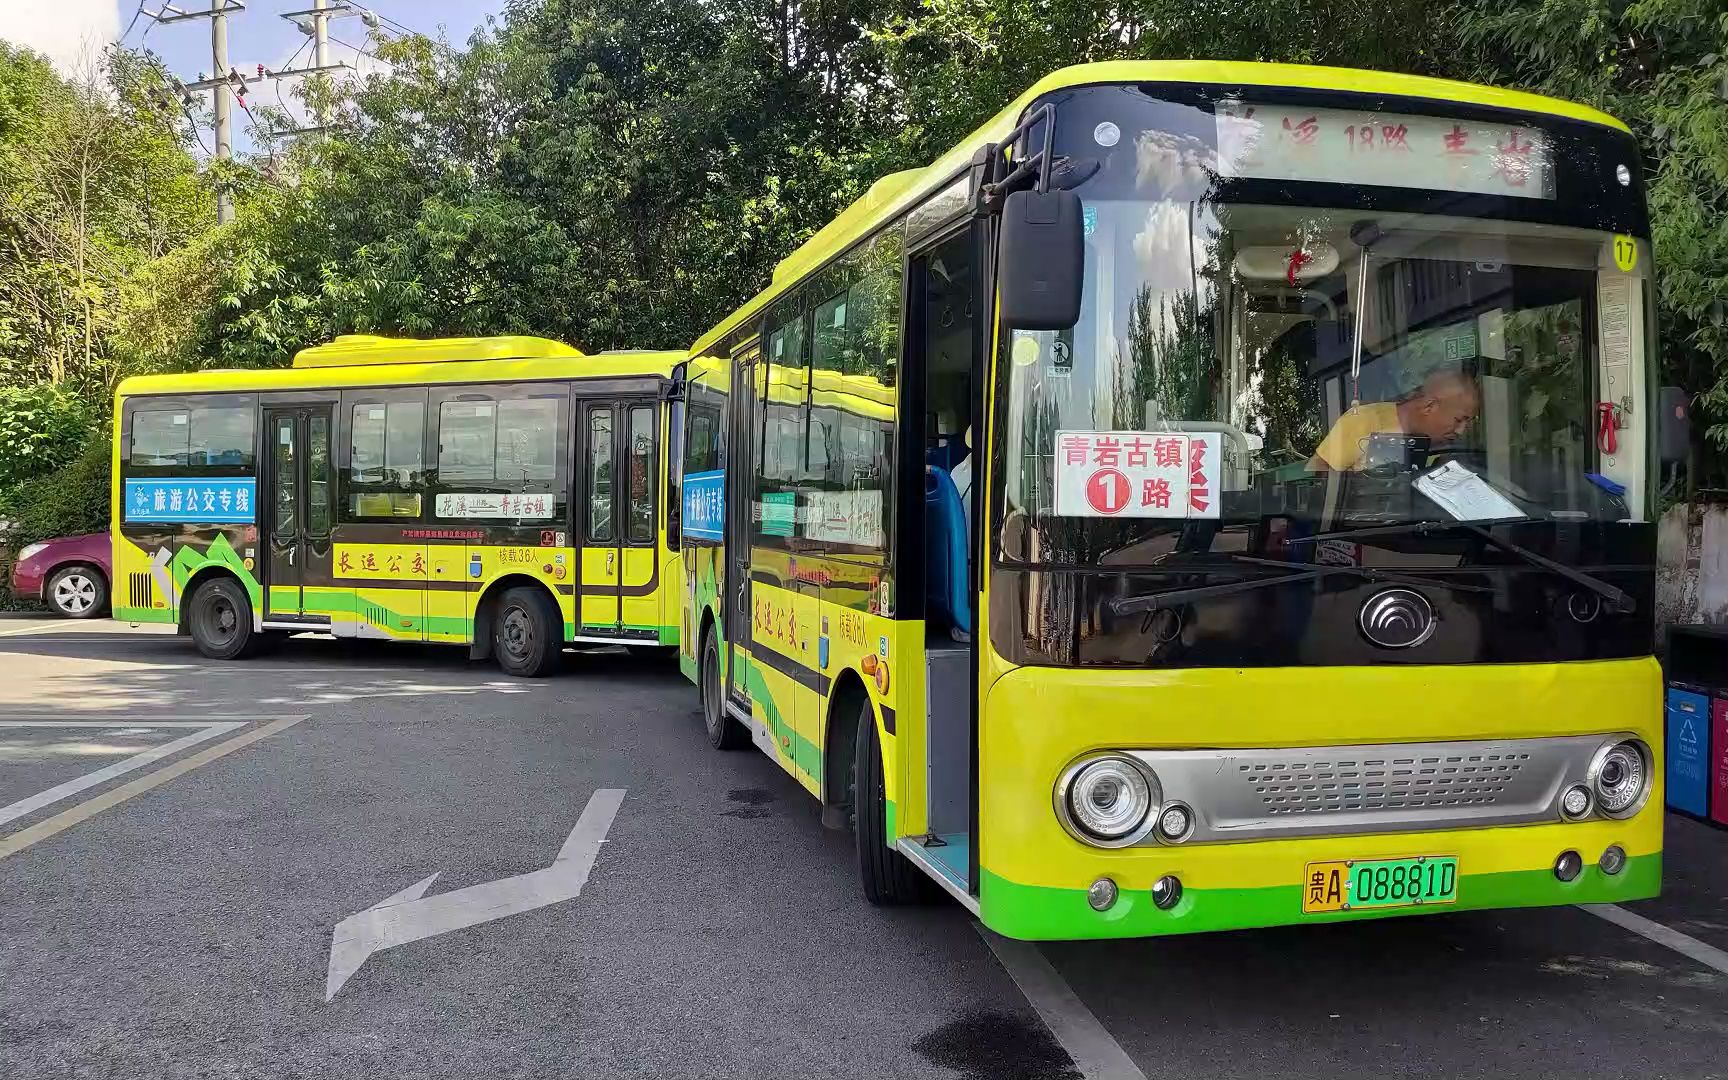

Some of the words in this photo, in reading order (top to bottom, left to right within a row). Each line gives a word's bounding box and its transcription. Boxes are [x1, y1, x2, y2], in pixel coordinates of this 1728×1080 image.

[1616, 241, 1634, 263] 17
[1062, 436, 1183, 468] 青岩古镇
[154, 487, 249, 513] 旅游公交专线
[441, 496, 467, 517] 花溪
[499, 495, 546, 517] 青岩古镇
[337, 550, 428, 575] 长运公交
[498, 547, 539, 564] 核载36人
[754, 594, 797, 650] 长运公交
[1309, 869, 1342, 905] 贵A
[1356, 862, 1456, 902] 08881D
